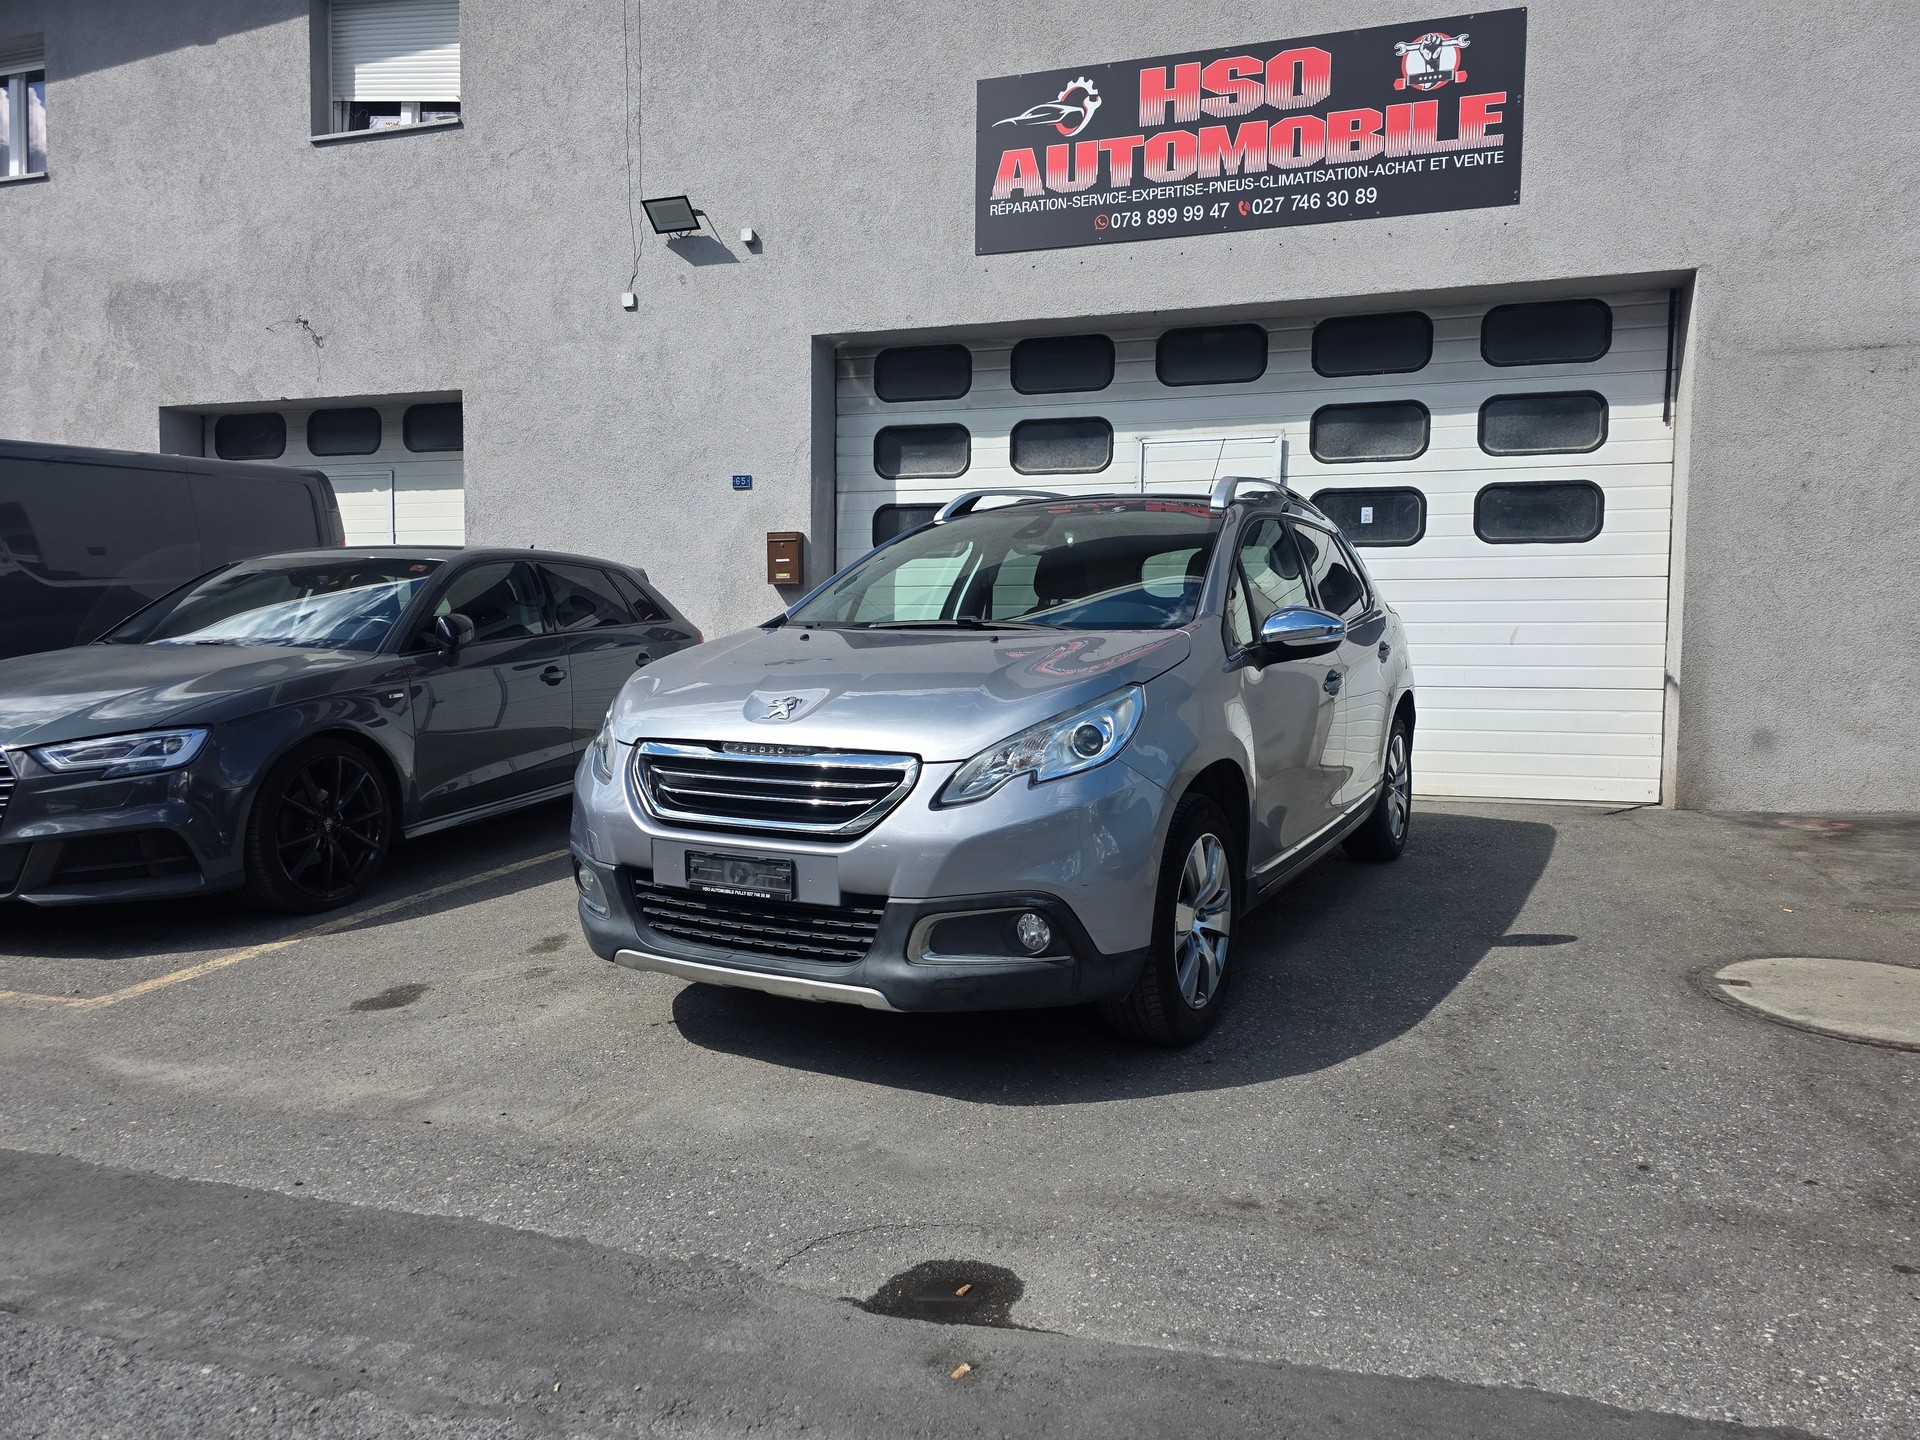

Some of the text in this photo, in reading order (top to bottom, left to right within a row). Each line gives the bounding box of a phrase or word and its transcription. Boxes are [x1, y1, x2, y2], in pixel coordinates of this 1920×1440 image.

[1139, 46, 1332, 127] HSO
[990, 91, 1507, 200] AUTOMOBILE
[989, 150, 1504, 216] RÉPARATION-SERVICE-EXPERTISE-PNEUS-CLIMATISATION-ACHAT ET VENTE
[1110, 187, 1378, 229] 078 899 99 47 027 746 30 89
